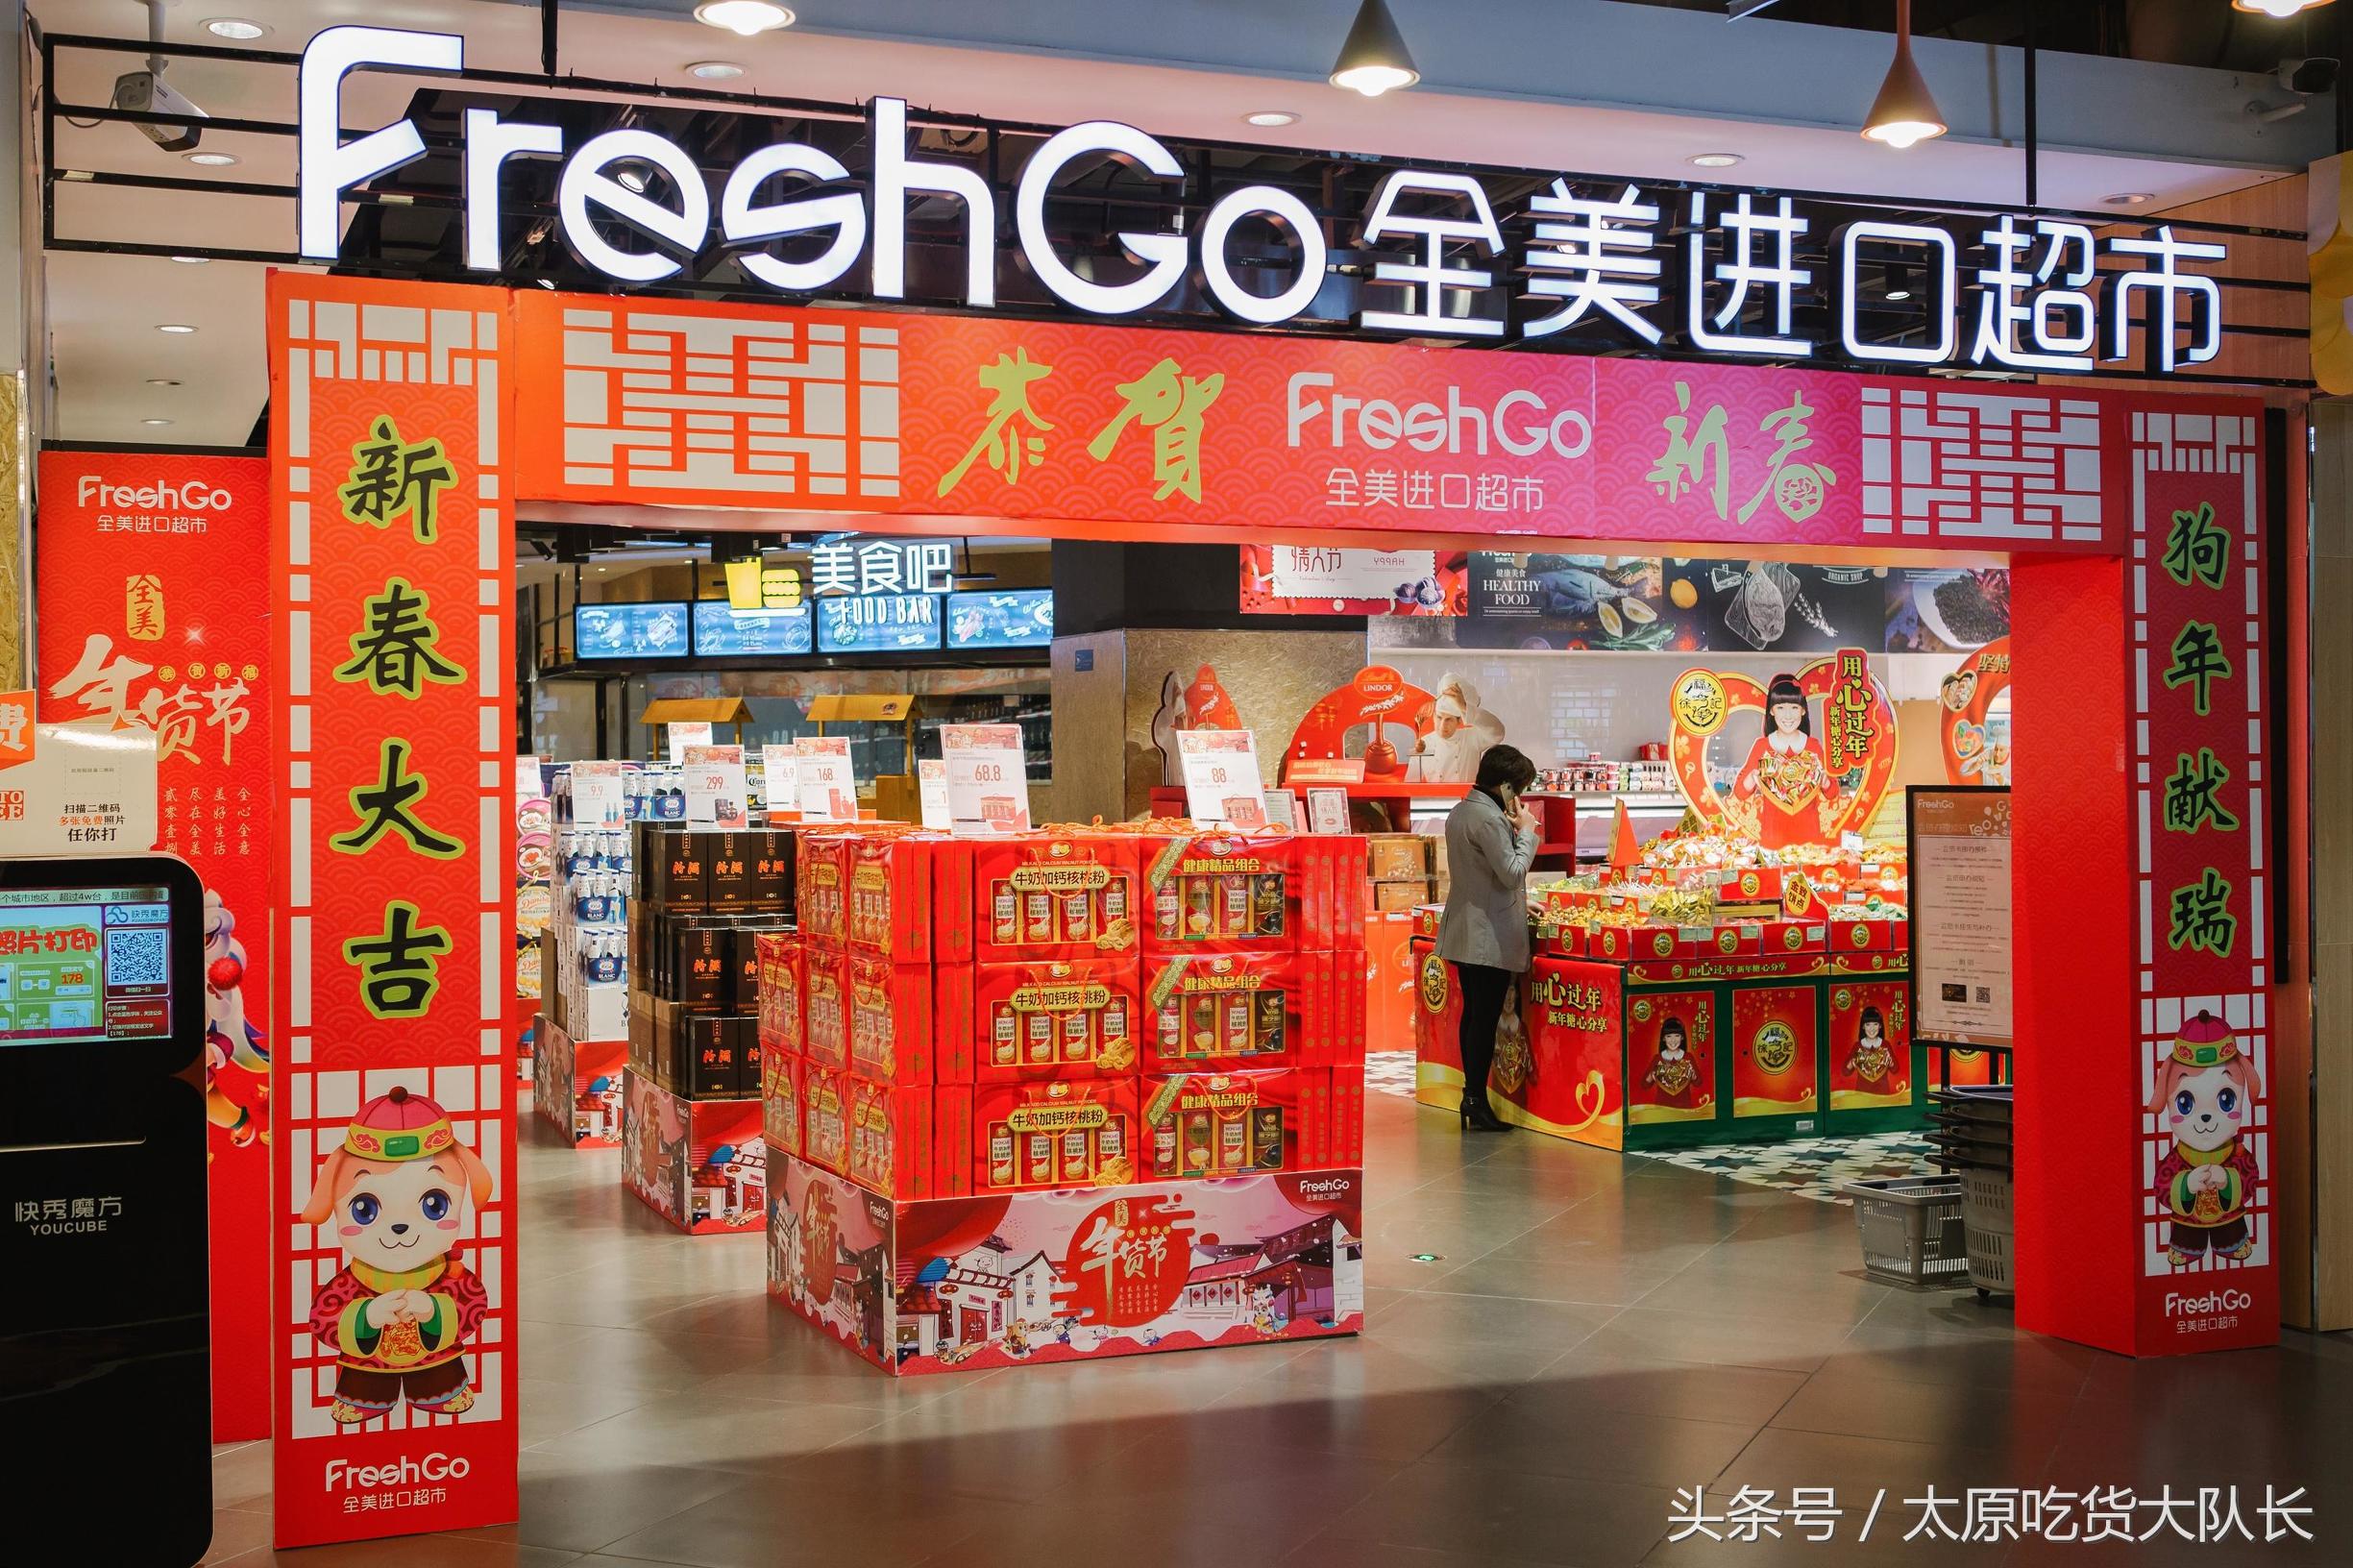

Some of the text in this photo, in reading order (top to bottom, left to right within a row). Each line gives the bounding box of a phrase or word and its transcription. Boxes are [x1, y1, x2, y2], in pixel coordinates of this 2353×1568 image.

[300, 26, 1327, 324] FreshGo
[1361, 169, 2226, 373] 全美进口超市
[938, 345, 1225, 504] 恭贺
[1287, 372, 1591, 460] FreshGo
[1645, 381, 1837, 524] 新春
[79, 476, 232, 510] FreshGo
[1325, 467, 1544, 514] 全美进口超市
[97, 515, 208, 533] 全美进口超市
[812, 541, 953, 595] 美食吧
[1496, 569, 1526, 577] 健康美食
[1483, 579, 1540, 592] HEALTHY
[1495, 594, 1530, 605] FOOD
[840, 597, 888, 625] FOOD
[896, 596, 934, 625] BAR
[46, 634, 251, 765] 年货节
[1842, 656, 1875, 758] 用心过年
[338, 423, 464, 1012] 新春大吉
[2166, 502, 2239, 956] 狗年献瑞
[706, 775, 723, 790] 299
[818, 768, 833, 781] 168
[974, 765, 1001, 782] 68.8
[1212, 767, 1227, 783] 88
[590, 784, 603, 796] 9.9
[64, 803, 120, 814] 扫描二维码
[60, 815, 126, 825] 多张免费照片
[212, 787, 227, 855] 美好生活
[237, 787, 251, 855] 全心全意
[67, 827, 117, 842] 任你打
[1183, 858, 1261, 872] 健康精品组合
[1015, 870, 1105, 886] 牛奶加钙核桃粉
[61, 973, 84, 985] 178
[1688, 962, 1734, 977] 用心过年
[1015, 989, 1106, 1007] 牛奶加钙核桃粉
[1531, 972, 1602, 1012] 用心过年
[1547, 1011, 1607, 1033] 新年糖心分享
[1181, 1091, 1259, 1110] 健康精品组合
[1013, 1109, 1104, 1127] 牛奶加钙核桃粉
[1300, 1179, 1350, 1193] FreshGo
[14, 1196, 122, 1222] 快秀魔方
[30, 1220, 108, 1236] YOUCUBE
[1080, 1216, 1167, 1323] 年货节
[2165, 1289, 2251, 1317] FreshGo
[2176, 1317, 2238, 1334] 全美进口超市
[326, 1452, 470, 1492] FreshGo
[343, 1488, 446, 1513] 全美进口超市
